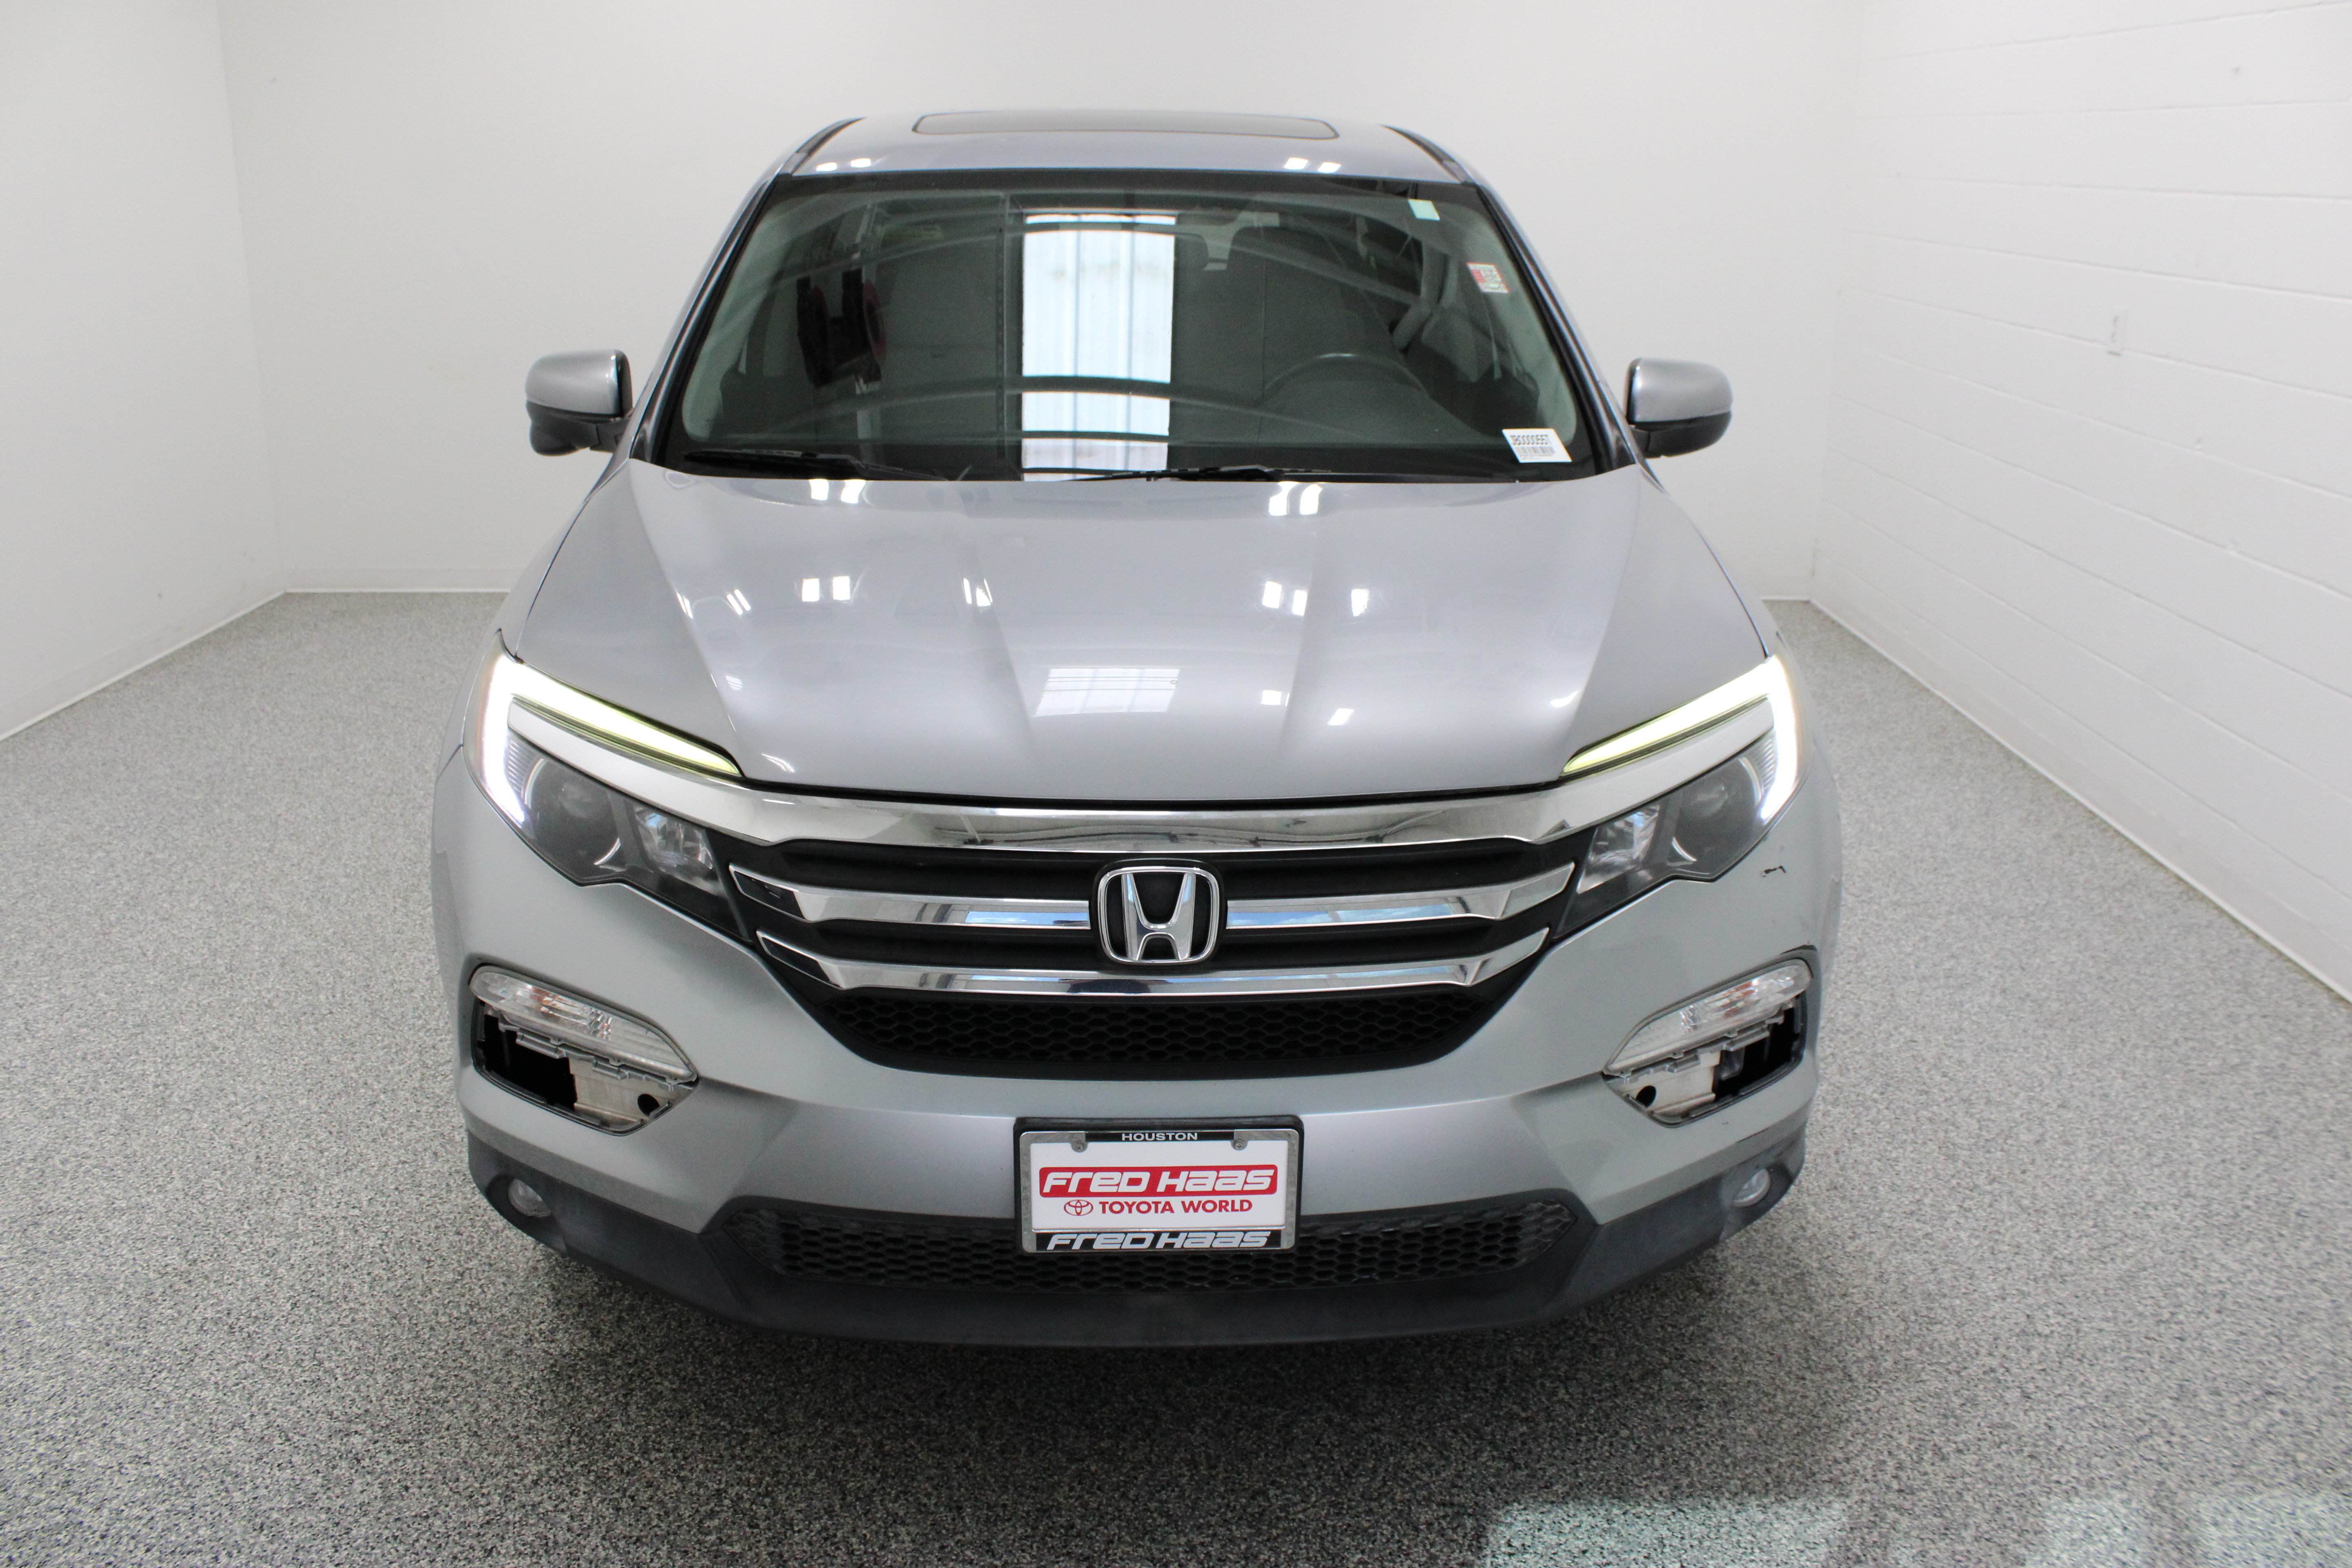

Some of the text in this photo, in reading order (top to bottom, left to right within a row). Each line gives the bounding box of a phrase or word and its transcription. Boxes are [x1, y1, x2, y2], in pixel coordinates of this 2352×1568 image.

[1122, 1132, 1198, 1141] HOUSTON
[1099, 1199, 1253, 1214] TOYOTA WORLD
